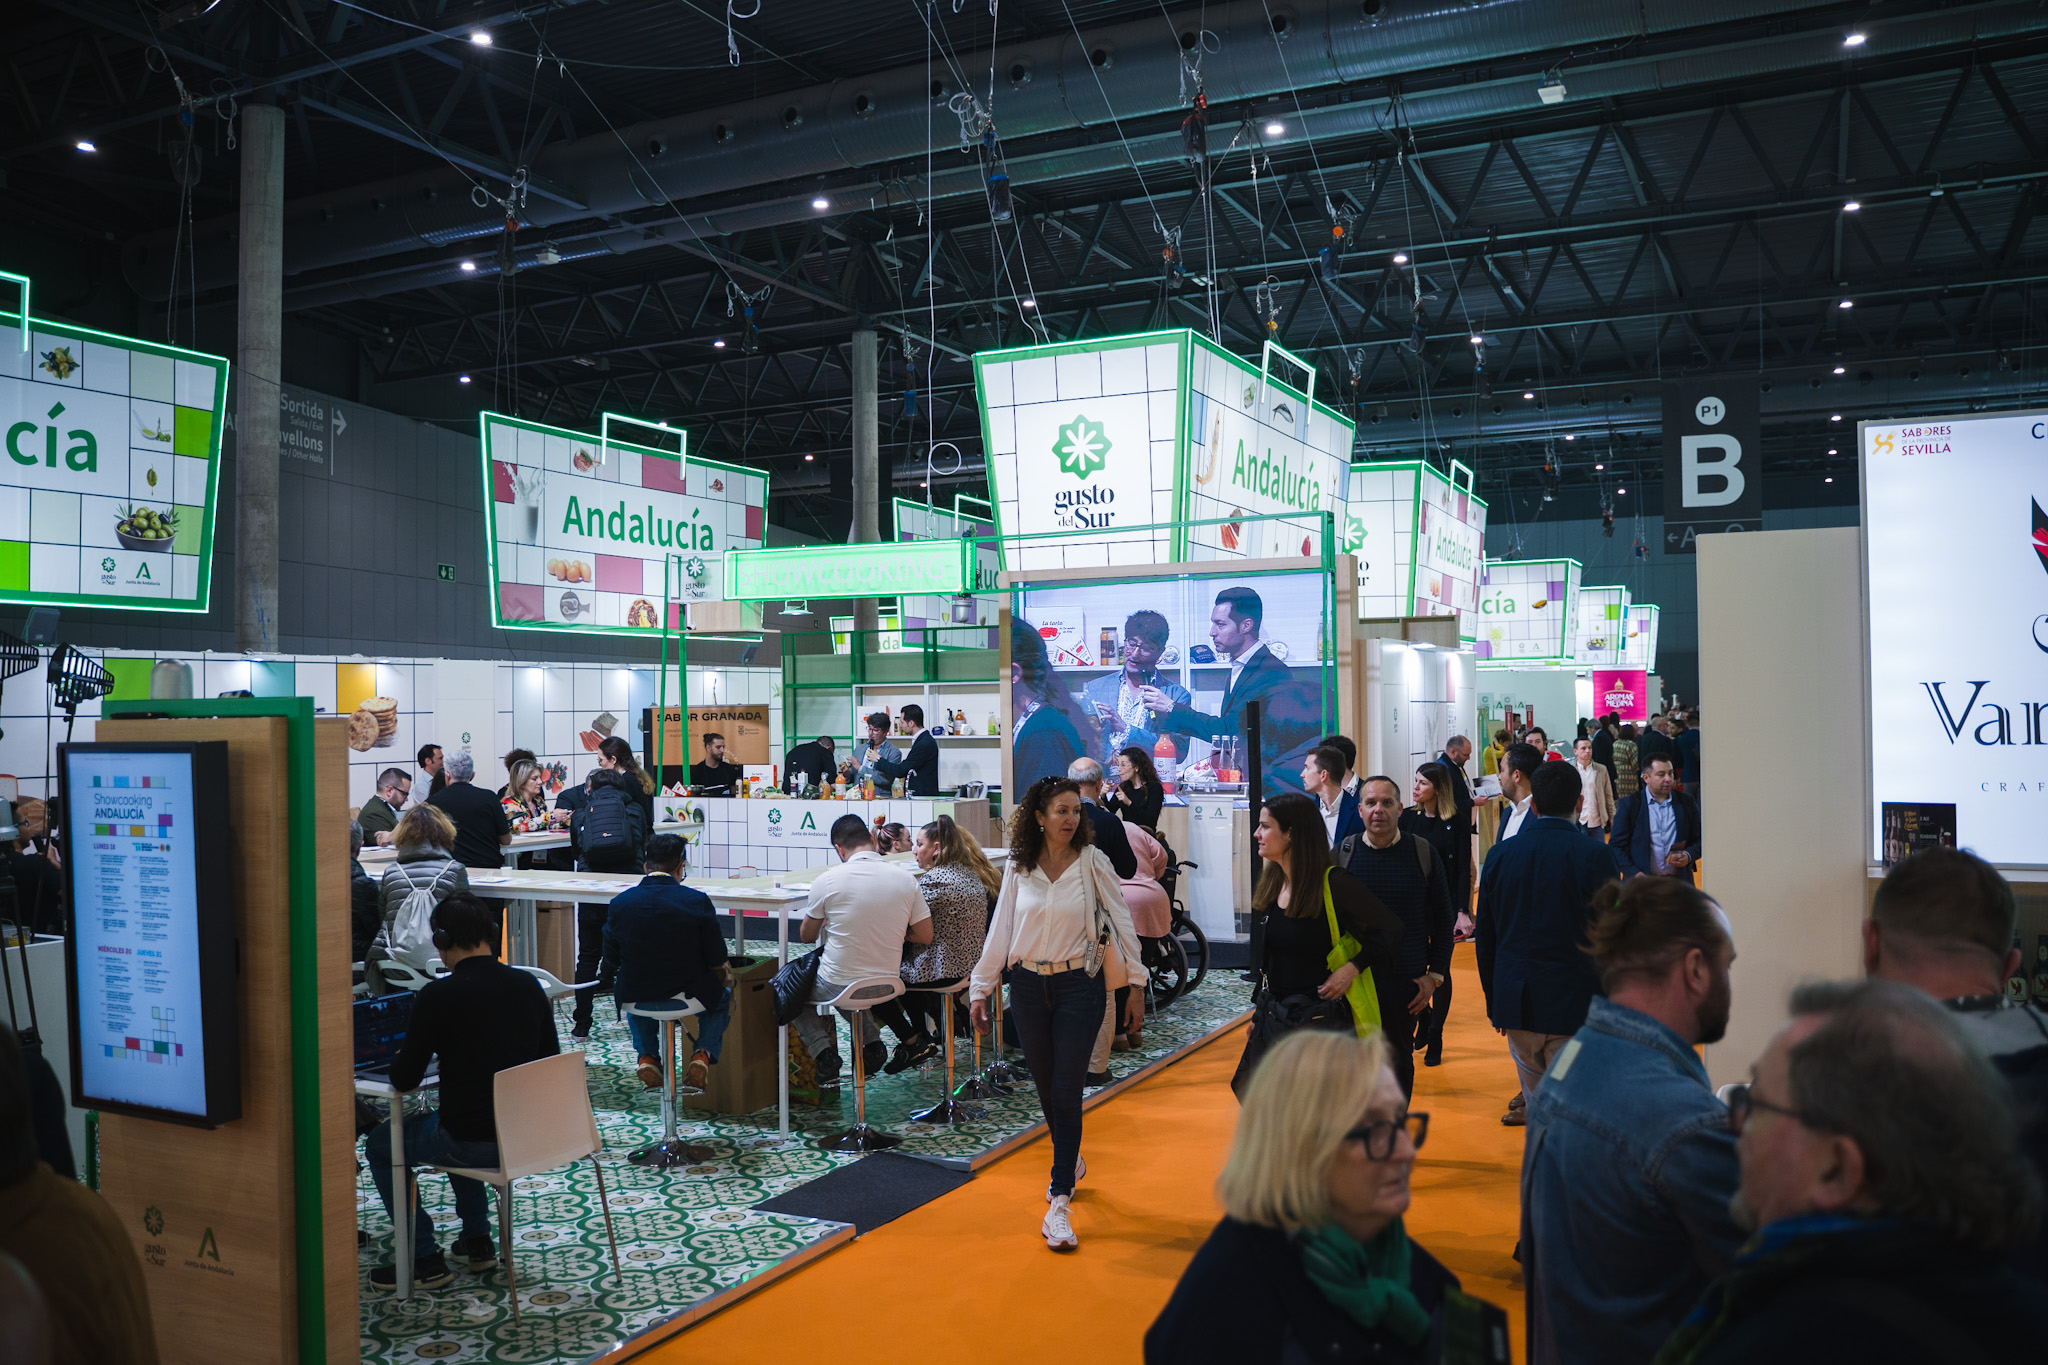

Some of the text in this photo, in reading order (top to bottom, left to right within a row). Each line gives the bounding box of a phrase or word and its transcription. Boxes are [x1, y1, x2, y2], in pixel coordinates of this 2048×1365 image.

[280, 393, 324, 420] Sortida
[1701, 404, 1718, 418] P1
[1901, 443, 1952, 456] SEVILLA
[1231, 438, 1320, 512] Andalucía
[1680, 433, 1746, 508] B
[1054, 483, 1115, 515] gusto
[562, 495, 714, 551] Andalucía
[1058, 506, 1115, 529] del Sur
[1435, 526, 1472, 571] Andalucía
[738, 554, 946, 587] SHOWCOOKING
[686, 582, 706, 592] gusto
[1604, 693, 1634, 701] AROMAS
[1605, 700, 1634, 708] MEDINA
[702, 712, 762, 721] GRANADA
[94, 793, 152, 809] Showcooking
[95, 805, 145, 819] ANDALUCÍA
[97, 945, 125, 954] MIÉRCOLES
[137, 949, 156, 957] JUEVES
